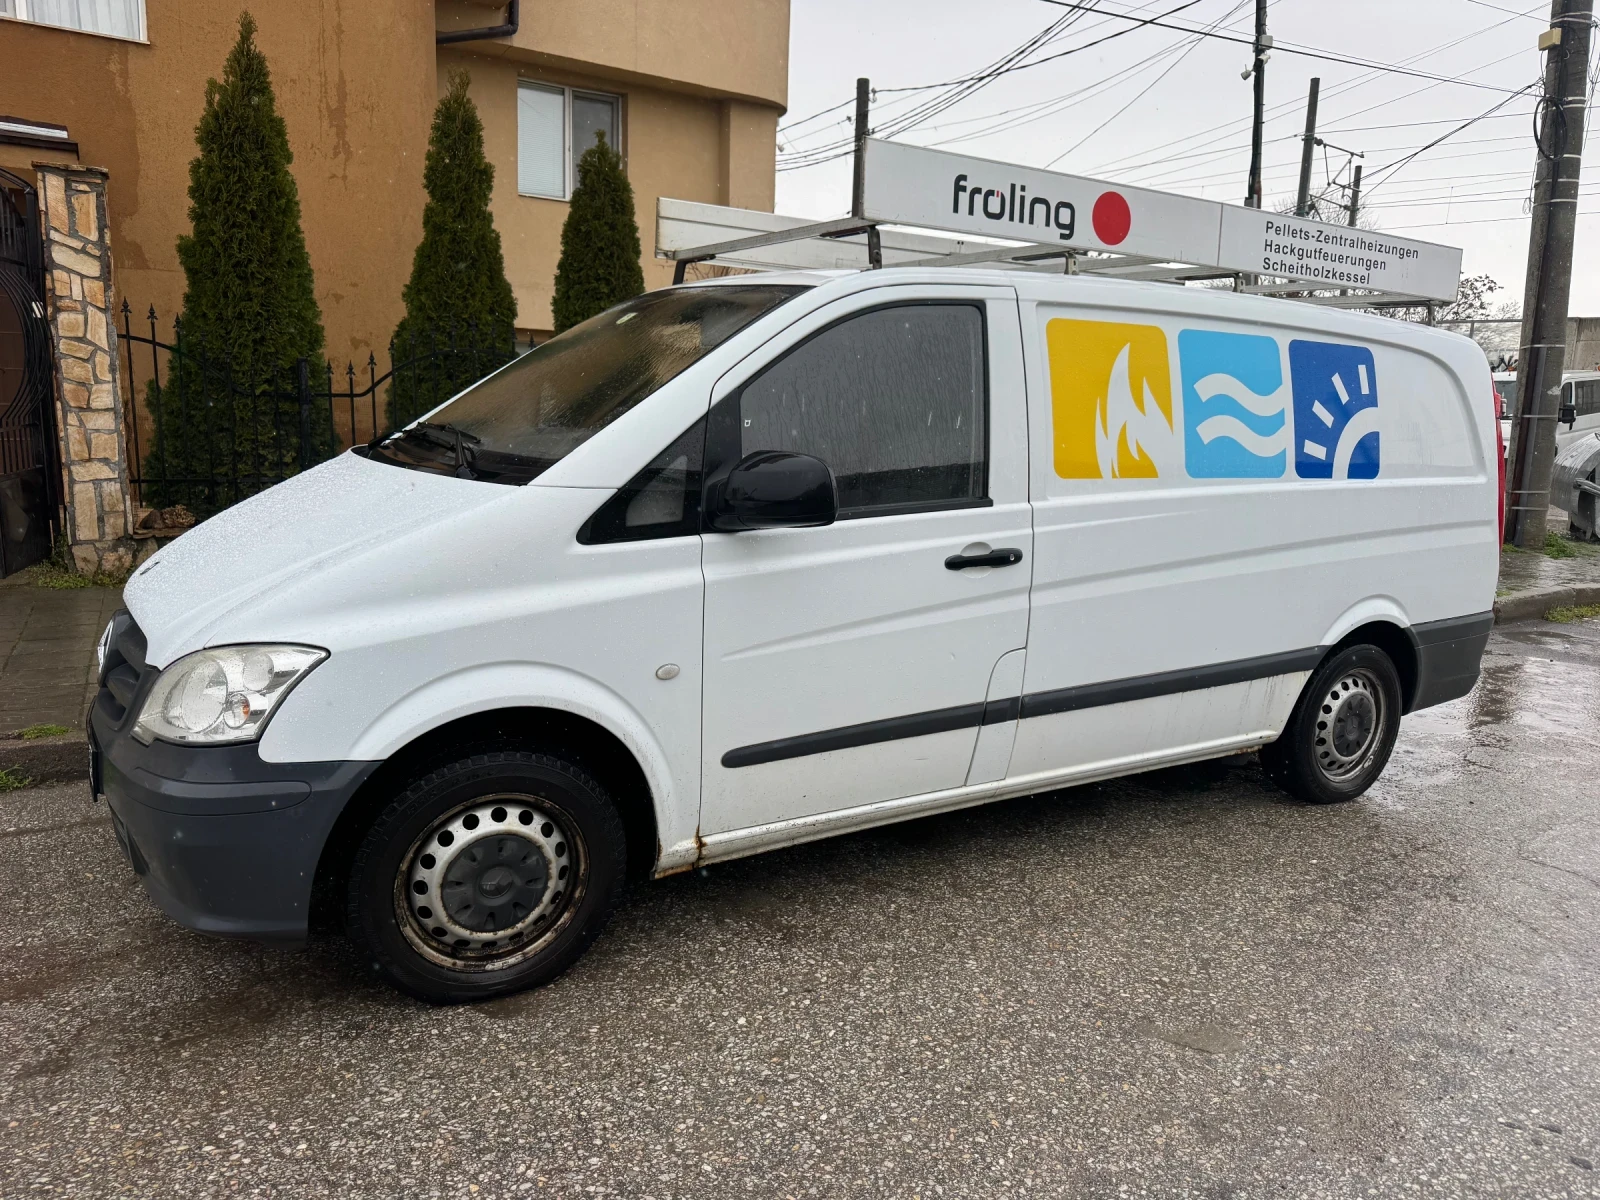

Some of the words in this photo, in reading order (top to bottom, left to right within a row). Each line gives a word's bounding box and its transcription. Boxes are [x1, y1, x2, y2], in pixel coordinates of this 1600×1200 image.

[1264, 239, 1386, 271] Hackgutfeuerungen
[1265, 220, 1419, 259] Pellets-Zentralheizungen
[1263, 257, 1370, 285] Scheitholzkessel
